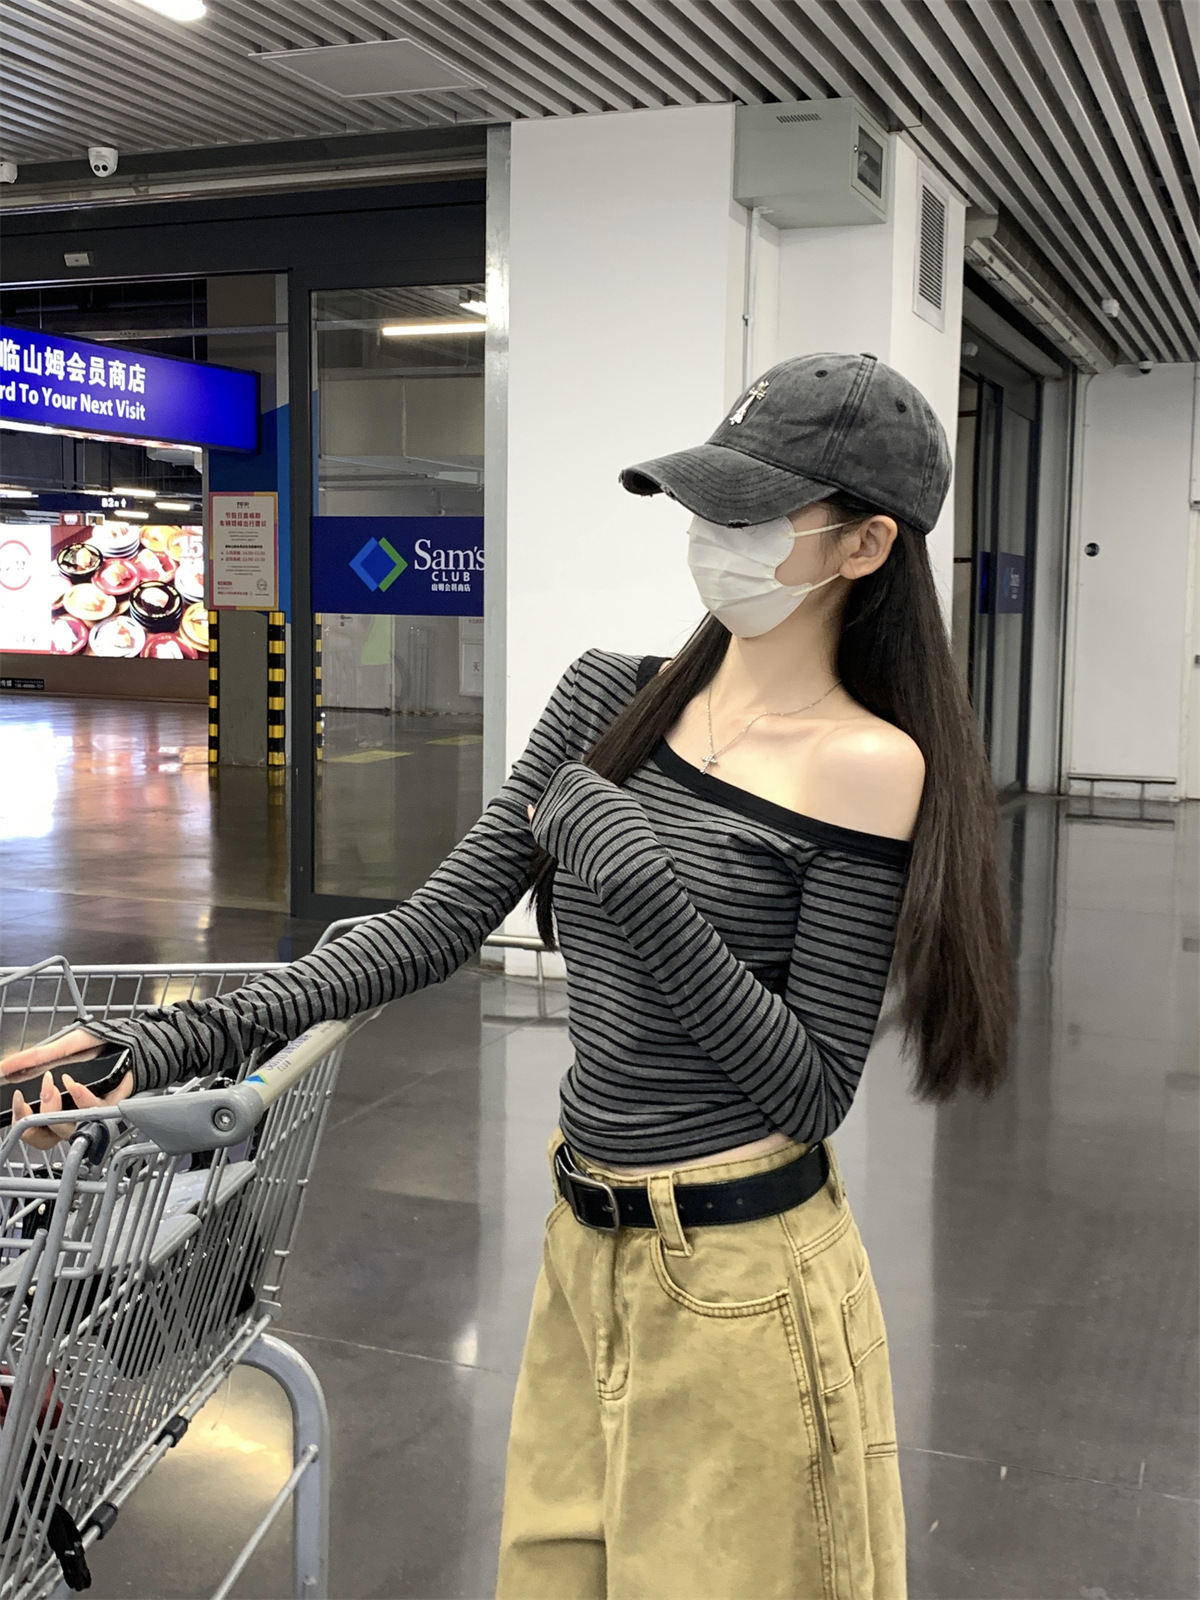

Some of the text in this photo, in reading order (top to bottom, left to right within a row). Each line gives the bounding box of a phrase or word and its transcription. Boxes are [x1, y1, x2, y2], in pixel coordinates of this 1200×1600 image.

[0, 338, 146, 394] 临山姆会员商店
[18, 383, 39, 405] To
[41, 386, 78, 411] Your
[80, 393, 114, 417] Next
[116, 400, 146, 421] Visit
[414, 538, 485, 571] Sam's
[431, 571, 471, 582] CLUB
